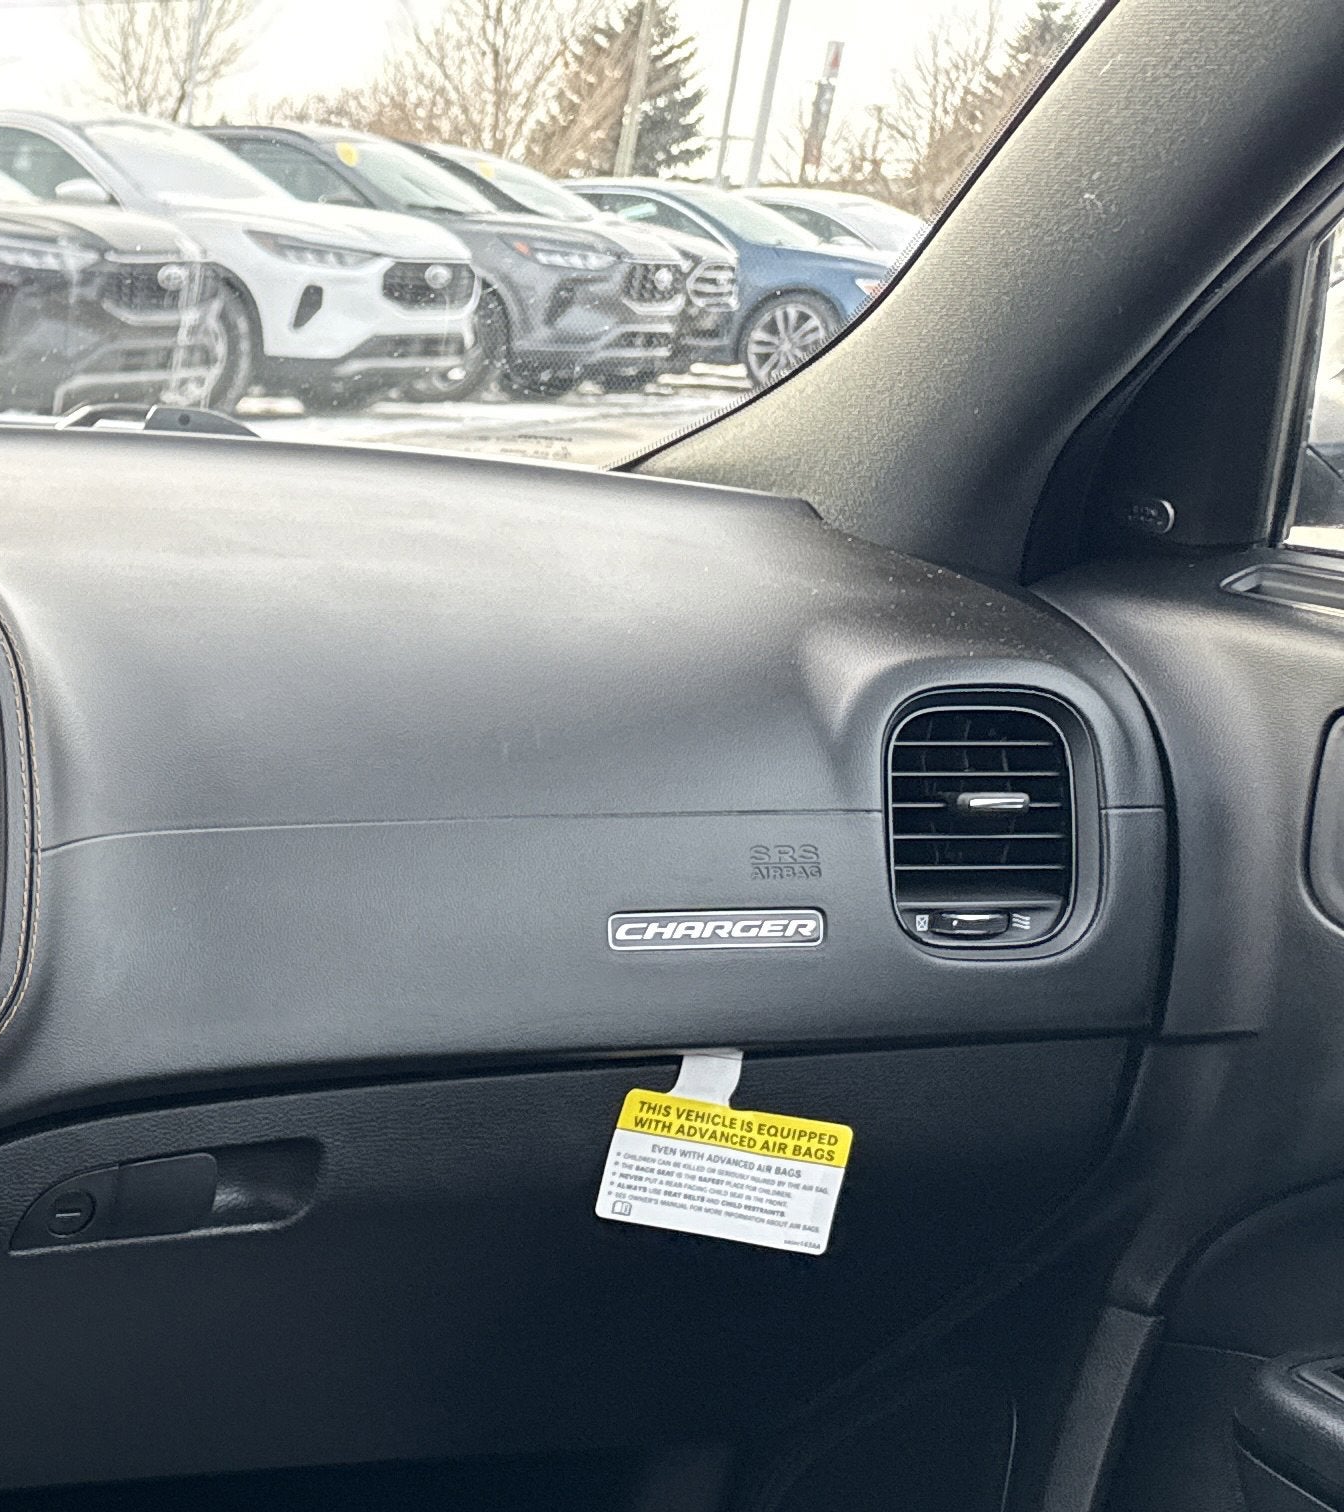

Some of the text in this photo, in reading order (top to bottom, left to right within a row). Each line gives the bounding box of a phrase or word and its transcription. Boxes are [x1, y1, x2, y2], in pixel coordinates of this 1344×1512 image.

[749, 843, 820, 863] SRS
[750, 865, 823, 880] AIRBAG
[614, 918, 818, 940] CHARGER
[638, 1100, 839, 1147] THIS VEHICLE IS EQUIPPED
[633, 1115, 836, 1163] WITH ADVANCED AIR BAGS
[651, 1143, 802, 1179] EVEN WITH ADVANCED AIR BAGS
